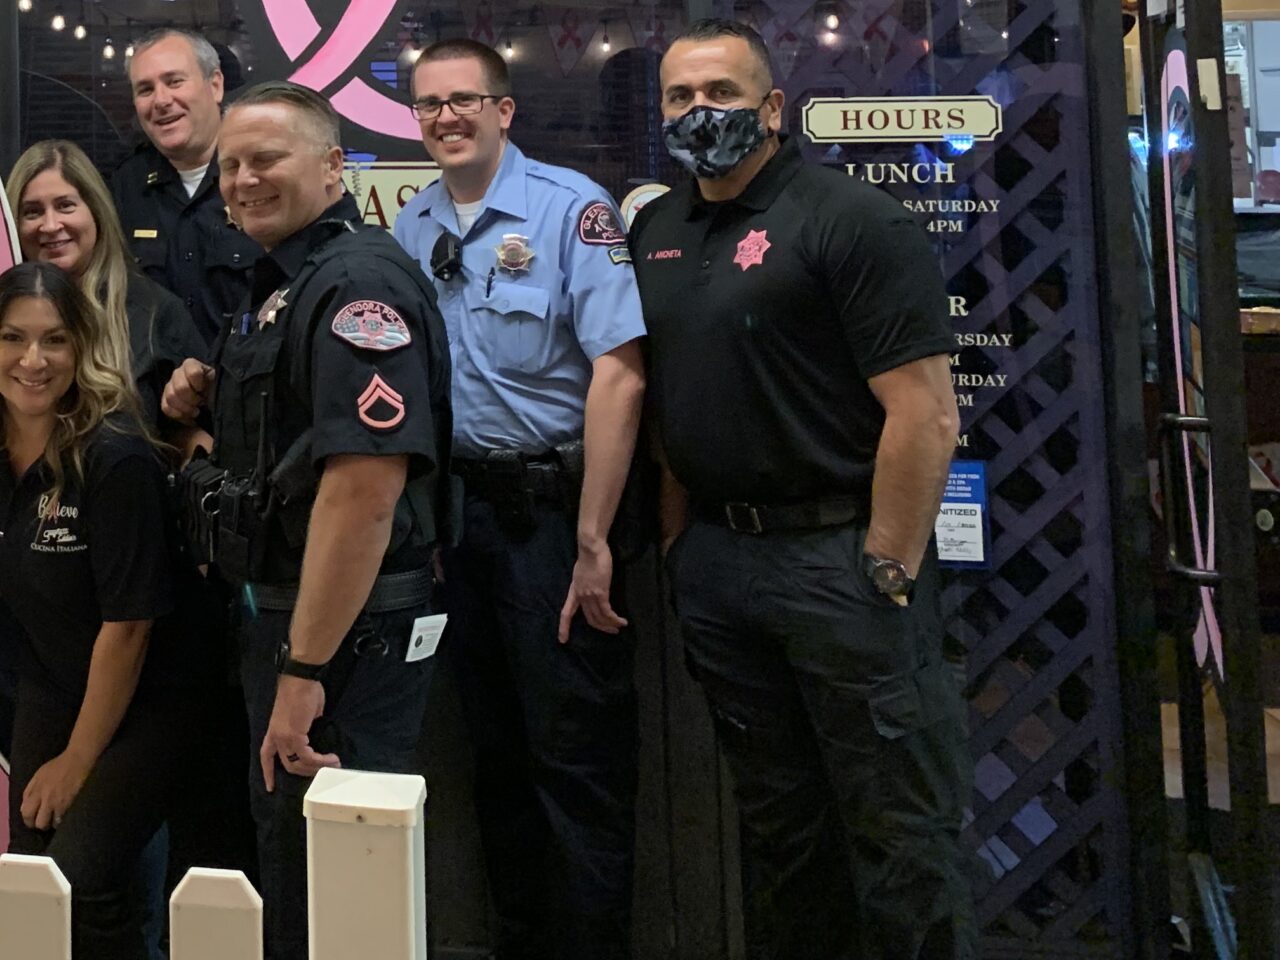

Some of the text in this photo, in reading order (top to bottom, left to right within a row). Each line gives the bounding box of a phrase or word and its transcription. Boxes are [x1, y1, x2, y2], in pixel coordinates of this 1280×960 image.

[840, 108, 966, 131] HOURS
[845, 162, 956, 184] LUNCH
[902, 200, 1000, 213] SATURDAY
[926, 220, 963, 233] 4PM
